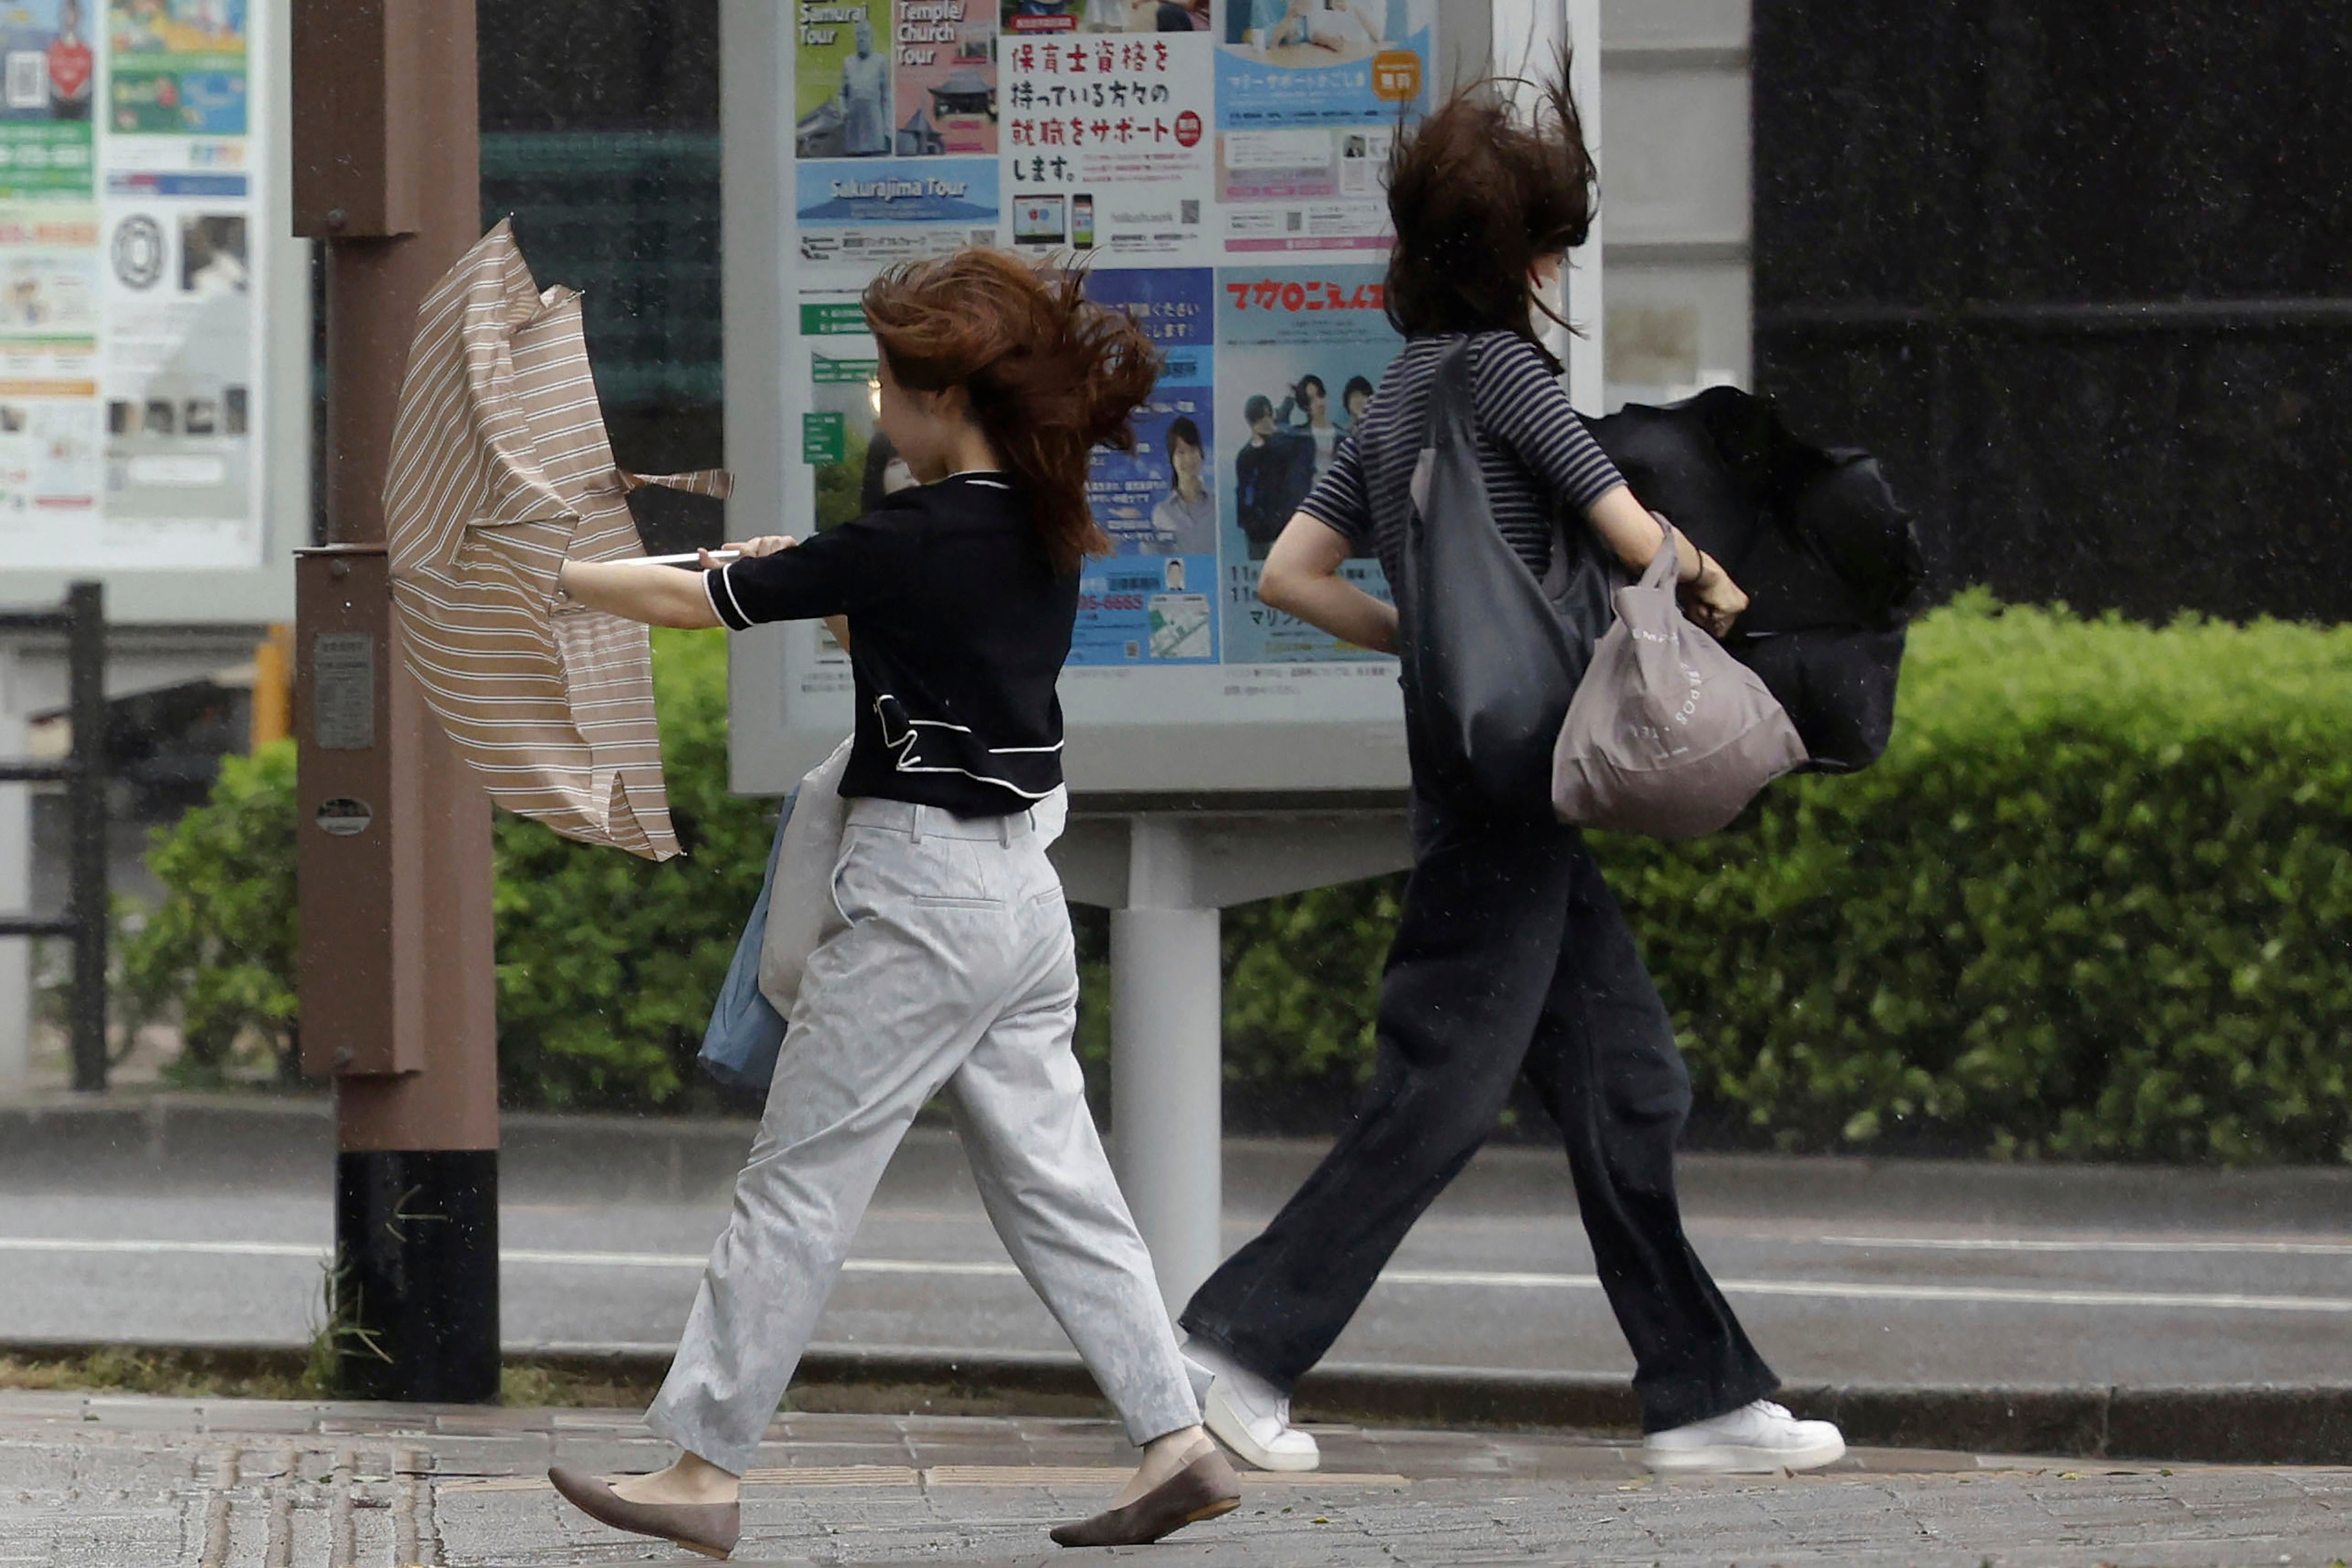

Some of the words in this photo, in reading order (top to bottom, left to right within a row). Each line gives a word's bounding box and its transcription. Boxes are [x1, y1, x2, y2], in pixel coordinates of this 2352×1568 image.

[799, 25, 837, 45] Tour
[897, 24, 955, 43] Church
[896, 45, 936, 65] Tour
[1012, 40, 1169, 73] 保育士資格を
[1010, 80, 1170, 109] 持っている方々の
[1011, 117, 1169, 146] 就職をサポート
[1014, 156, 1075, 182] します。
[926, 177, 968, 198] Tour
